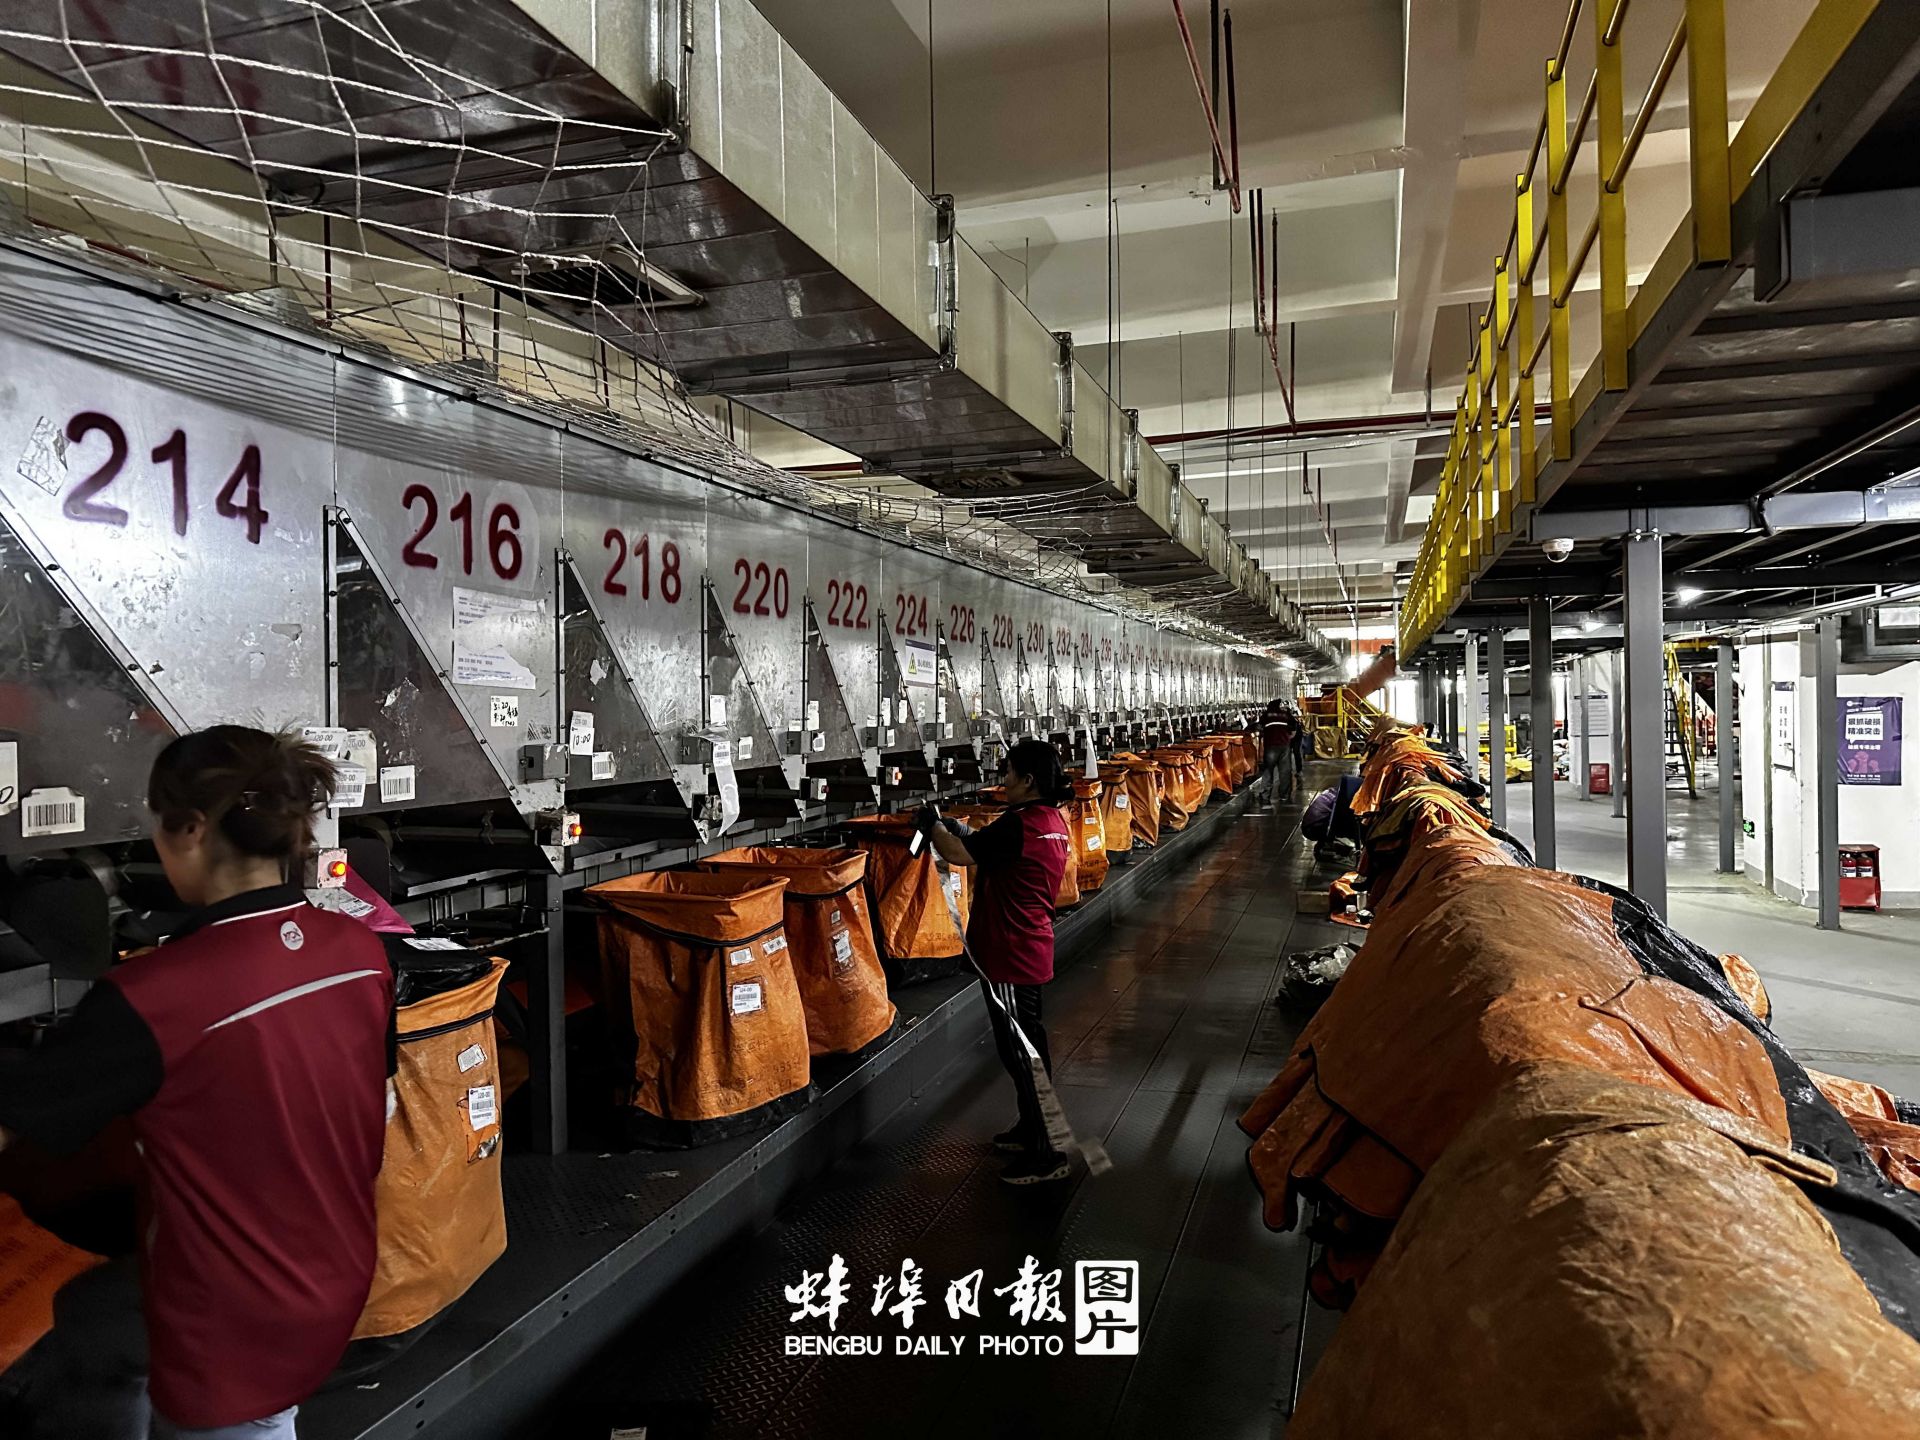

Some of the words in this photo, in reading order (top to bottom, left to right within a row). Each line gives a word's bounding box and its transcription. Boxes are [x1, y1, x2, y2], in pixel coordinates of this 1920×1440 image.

[62, 410, 270, 544] 214
[402, 483, 523, 580] 216
[603, 528, 681, 604] 218
[733, 558, 789, 619] 220
[827, 579, 868, 629] 222
[895, 594, 928, 637] 224
[950, 604, 975, 645] 226
[993, 613, 1014, 650] 228
[1026, 621, 1045, 654] 230
[1056, 626, 1071, 657] 232
[1080, 632, 1093, 659] 234
[1100, 637, 1112, 663] 236
[572, 733, 592, 750] 10:00
[1847, 727, 1881, 736] 精准突击
